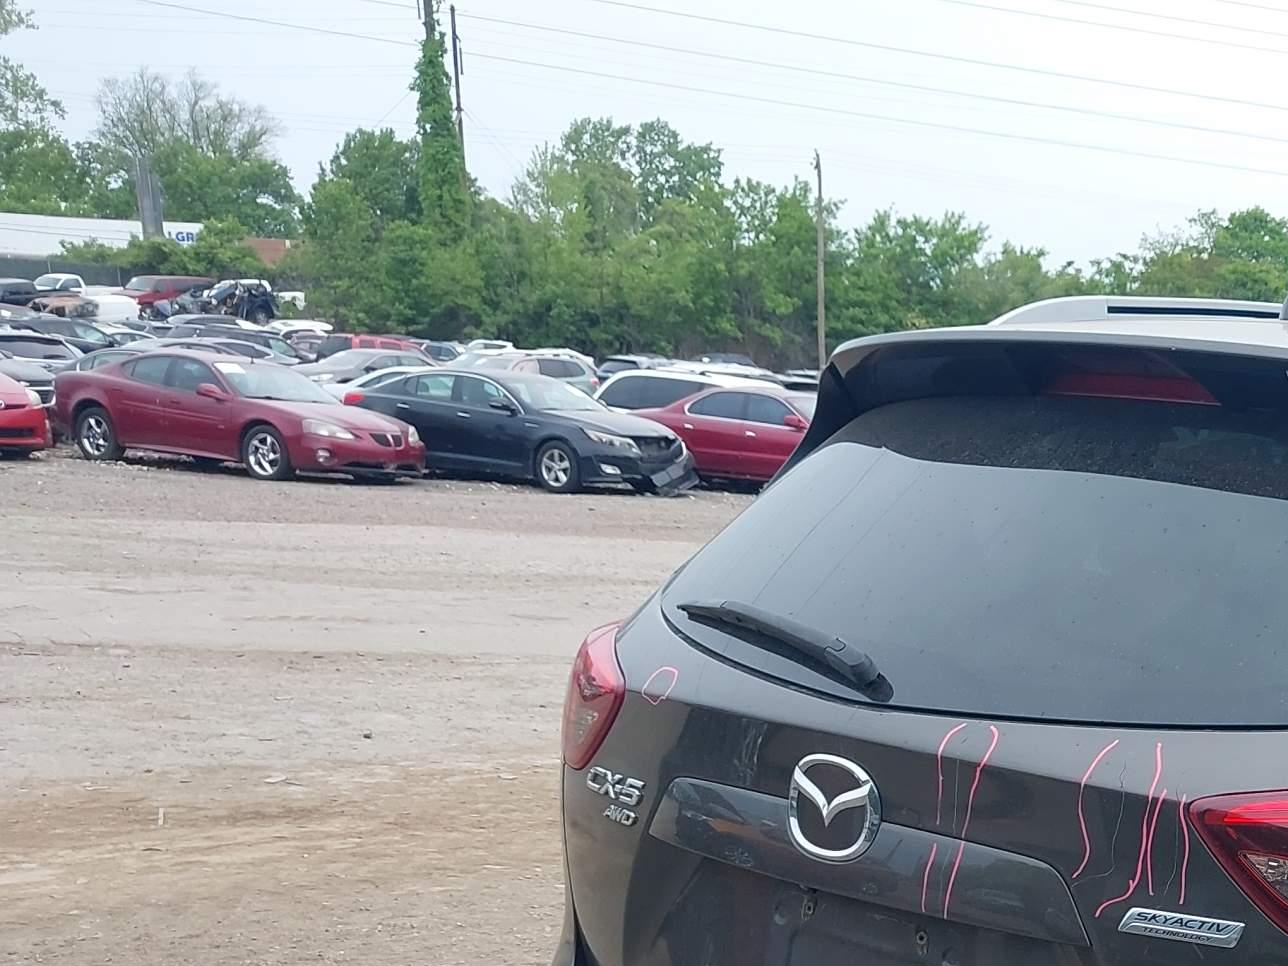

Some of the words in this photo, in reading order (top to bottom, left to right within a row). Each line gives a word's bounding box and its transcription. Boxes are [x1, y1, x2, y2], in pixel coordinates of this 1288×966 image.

[587, 766, 646, 806] CX-5
[602, 804, 638, 825] AWD
[1135, 911, 1232, 934] SKYACTIV
[1143, 927, 1214, 942] TECHNOLOGY
